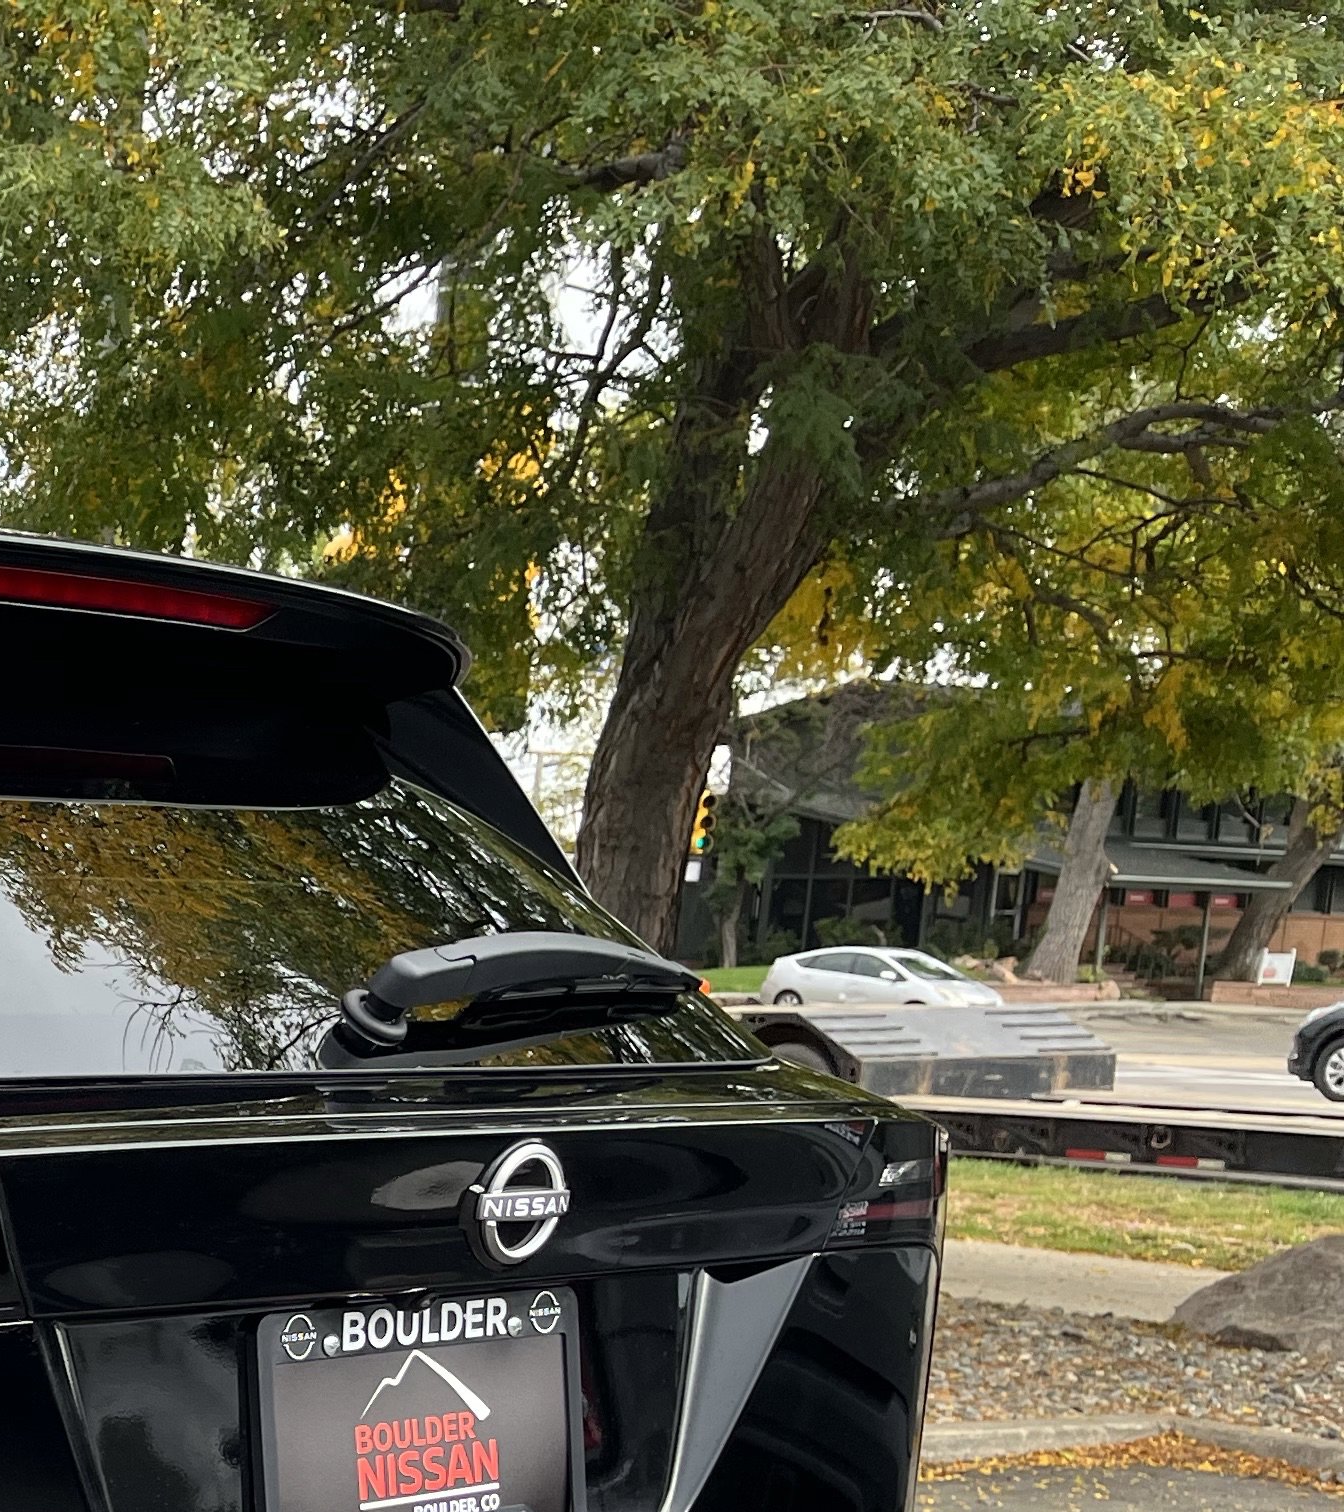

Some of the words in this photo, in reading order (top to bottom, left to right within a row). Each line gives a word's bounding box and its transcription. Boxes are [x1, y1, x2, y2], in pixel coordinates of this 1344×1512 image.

[483, 1195, 569, 1218] NISSAN
[528, 1306, 562, 1319] NISSAN
[342, 1297, 508, 1352] BOULDER
[280, 1330, 318, 1344] NISSAN
[353, 1411, 477, 1455] BOULDER
[356, 1438, 500, 1501] NISSAN
[480, 1493, 501, 1512] CO
